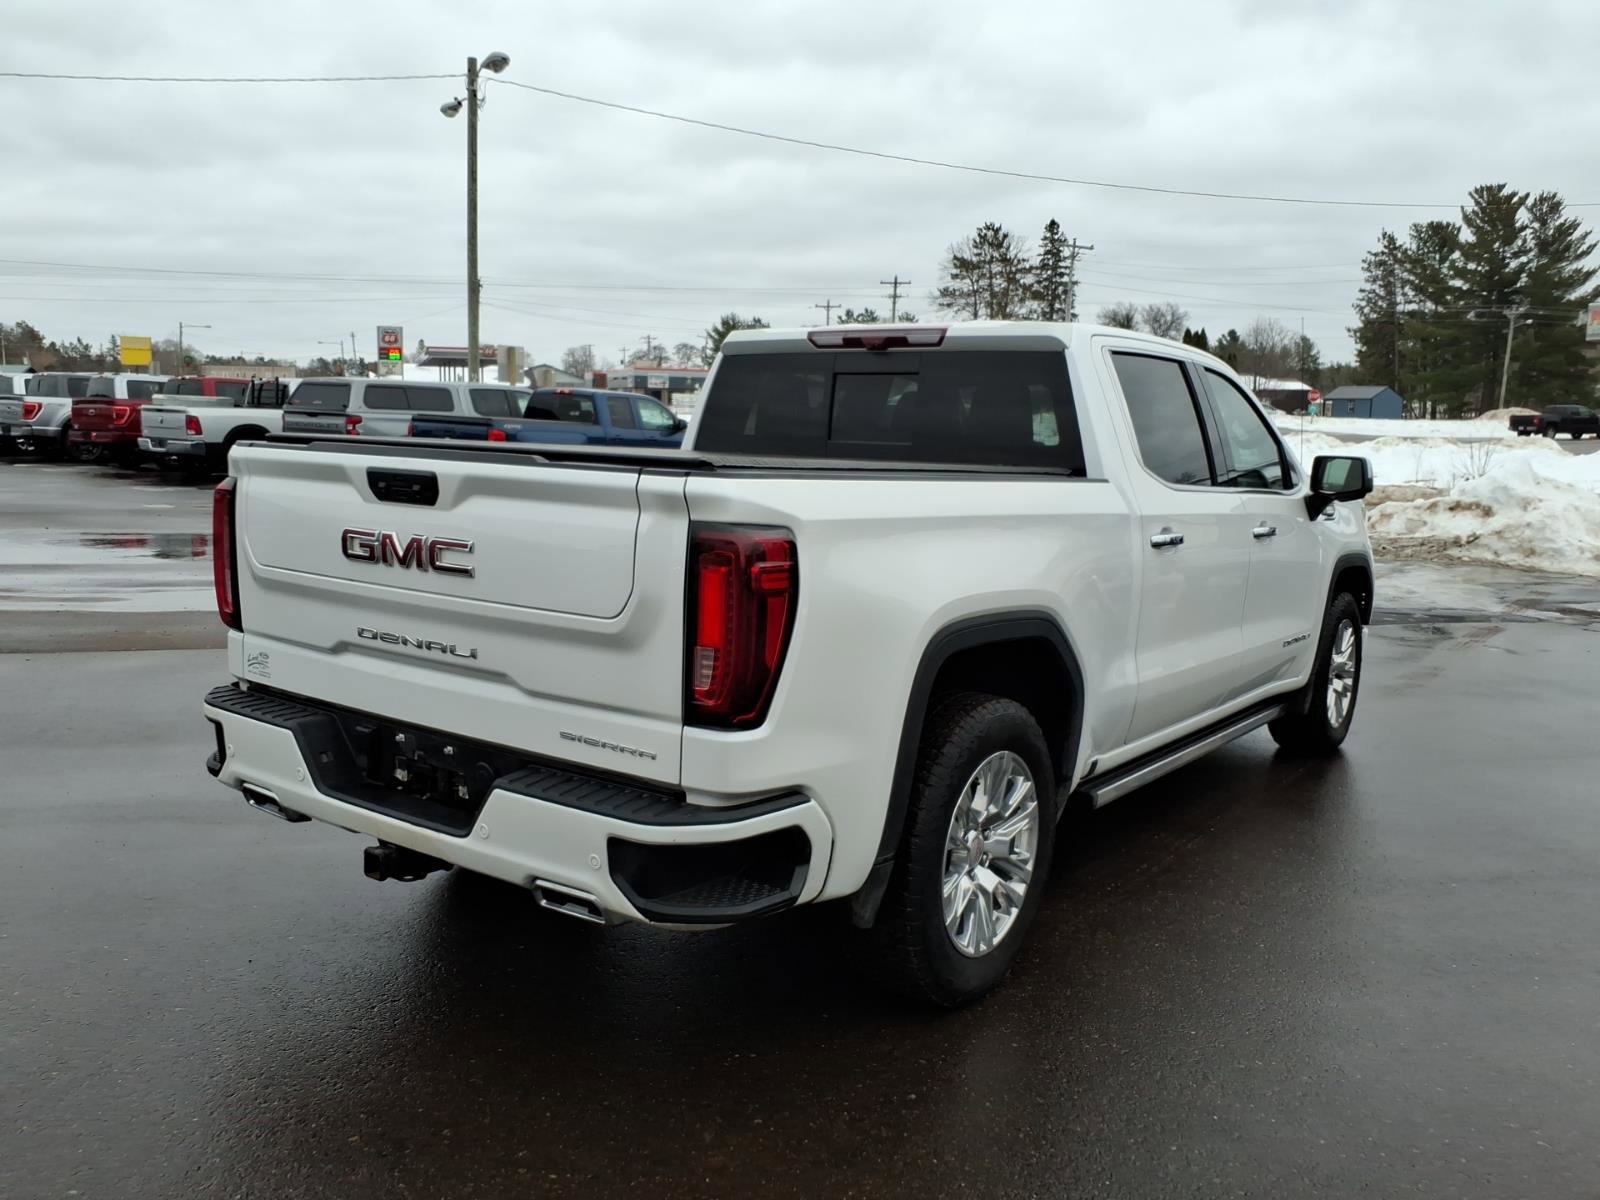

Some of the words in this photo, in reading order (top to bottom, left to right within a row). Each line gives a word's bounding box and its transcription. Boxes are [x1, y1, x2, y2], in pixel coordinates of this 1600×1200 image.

[341, 527, 475, 578] GMC
[357, 626, 478, 659] DENALI
[559, 731, 657, 760] SIERRA
